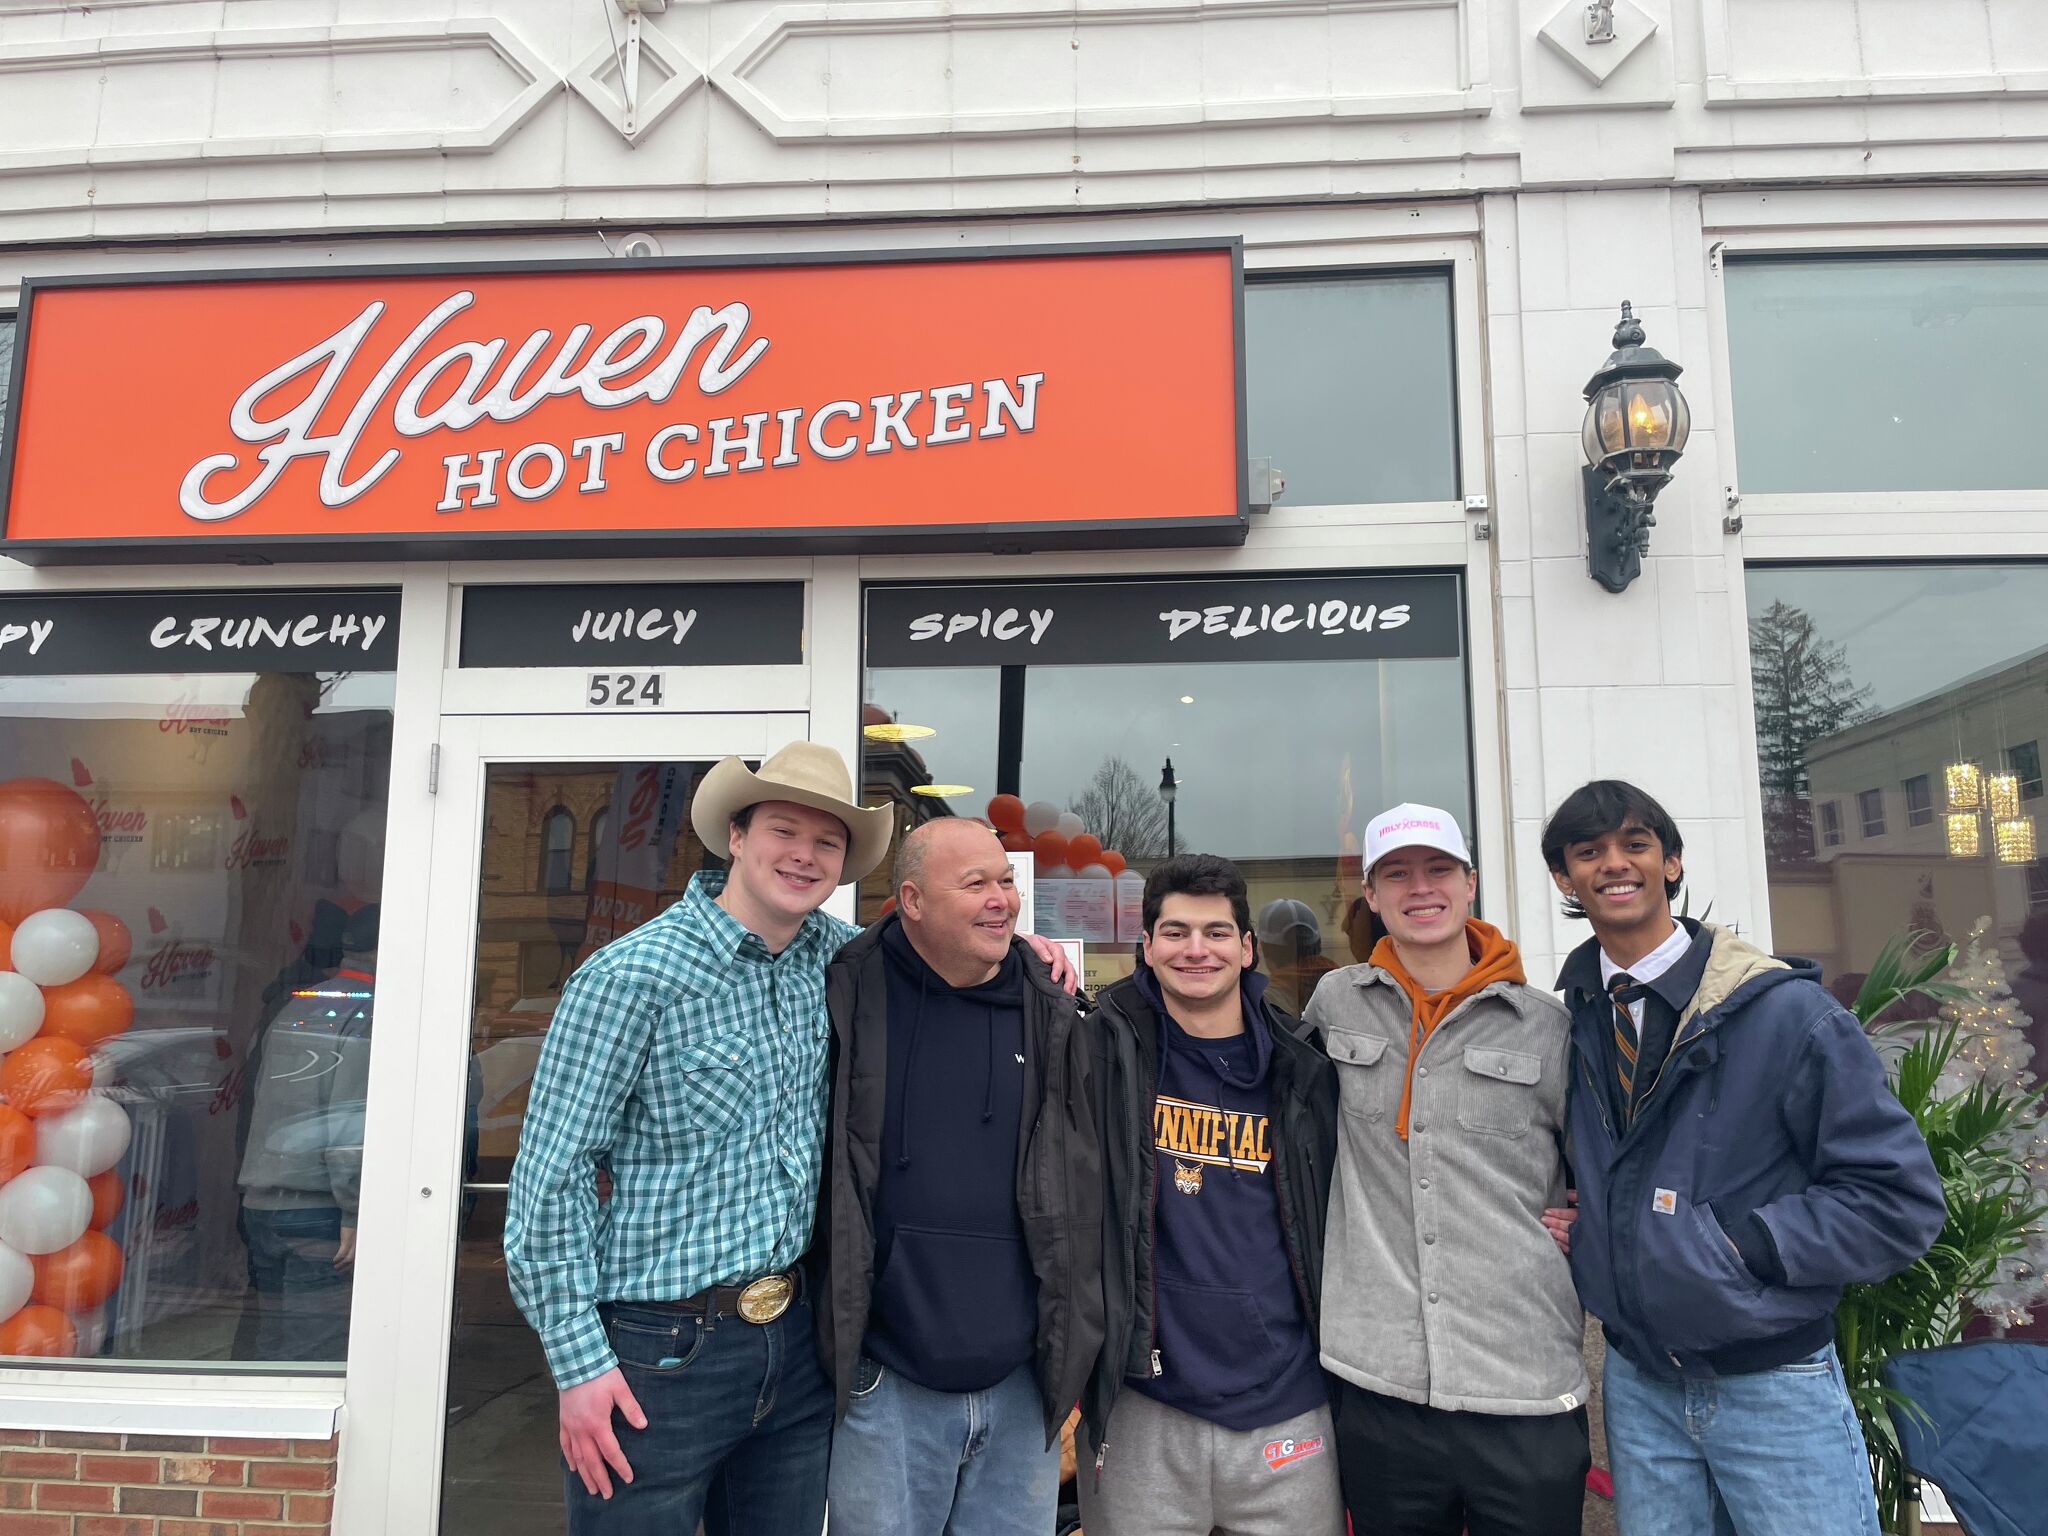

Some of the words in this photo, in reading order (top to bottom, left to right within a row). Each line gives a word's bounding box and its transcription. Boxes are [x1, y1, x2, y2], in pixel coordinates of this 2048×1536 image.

[177, 289, 771, 523] Haven
[435, 431, 625, 513] HOT
[645, 371, 1047, 484] CHICKEN
[150, 613, 386, 651] CRUNCHY
[572, 608, 697, 645] JUICY
[908, 608, 1055, 645] SPICY
[1159, 600, 1411, 641] DELICIOUS
[589, 674, 662, 706] 524
